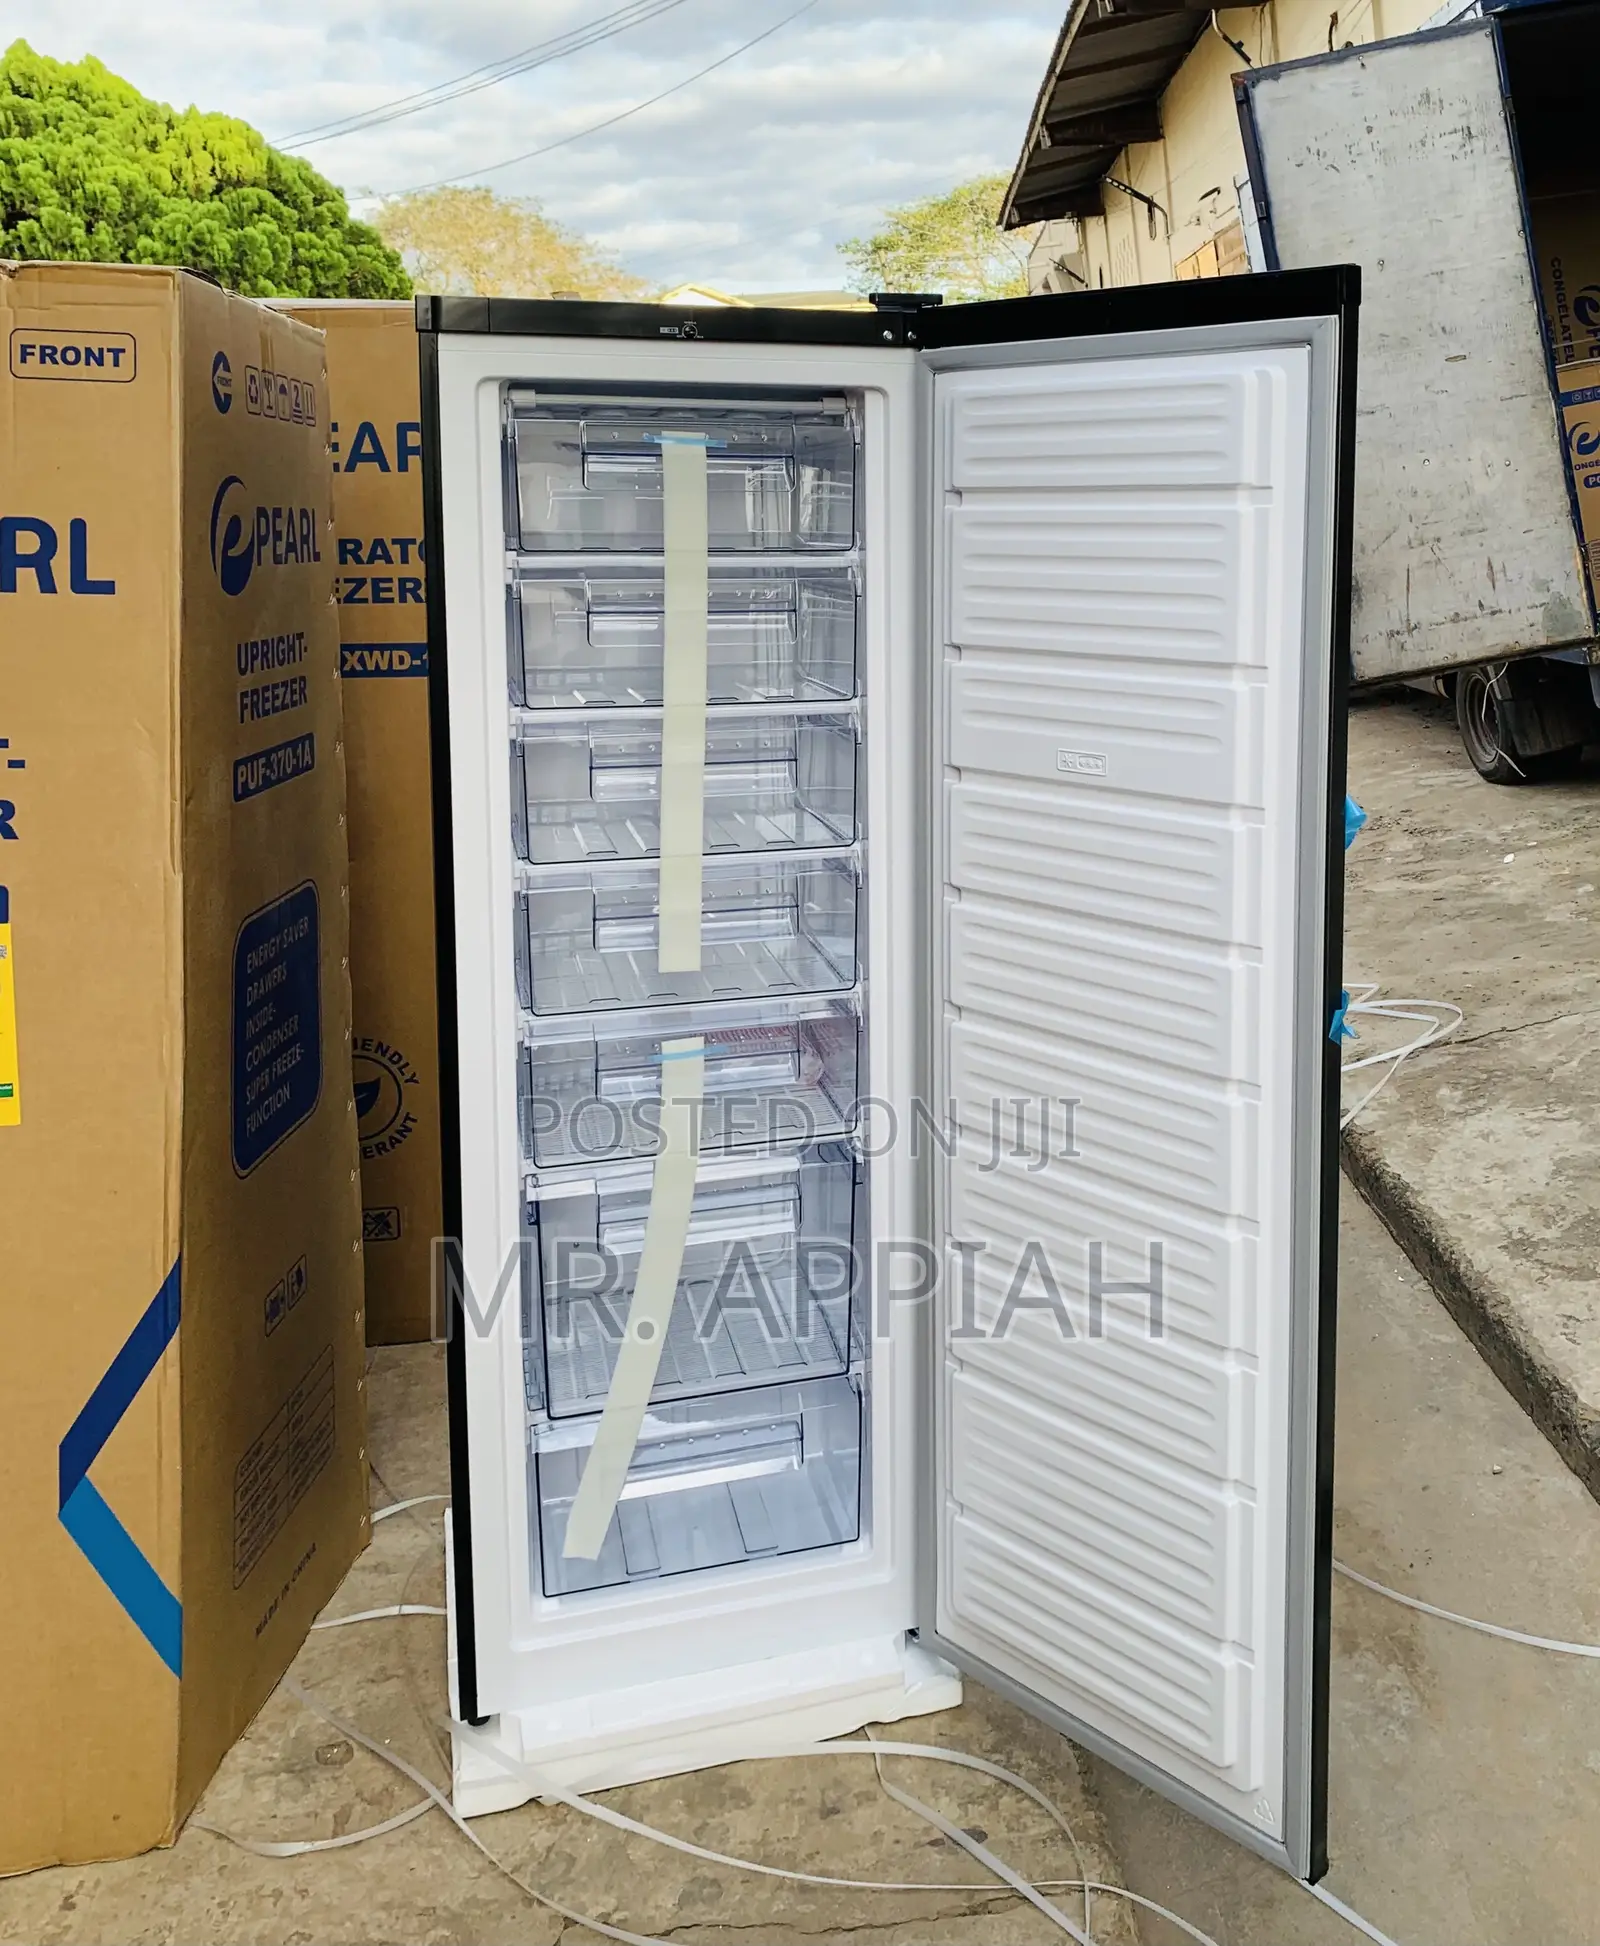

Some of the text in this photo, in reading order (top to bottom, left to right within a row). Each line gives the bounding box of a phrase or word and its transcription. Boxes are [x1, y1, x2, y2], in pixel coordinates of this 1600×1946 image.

[19, 343, 126, 368] FRONT
[0, 516, 116, 595] RL
[256, 506, 321, 567] PEARL
[337, 538, 425, 565] RAT
[335, 577, 427, 604] ZER
[237, 631, 308, 677] UPRIGHT-
[239, 675, 308, 724] FREEZER
[237, 739, 312, 795] PUF-370-1A
[247, 916, 310, 975] ENERGY SAVER
[246, 961, 288, 1007] DRAWERS
[246, 1002, 276, 1041] INSIDE-
[246, 1014, 300, 1072] CONDENSER
[246, 1042, 305, 1105] SUPER FREEZE-
[246, 1081, 291, 1138] FUNCTION
